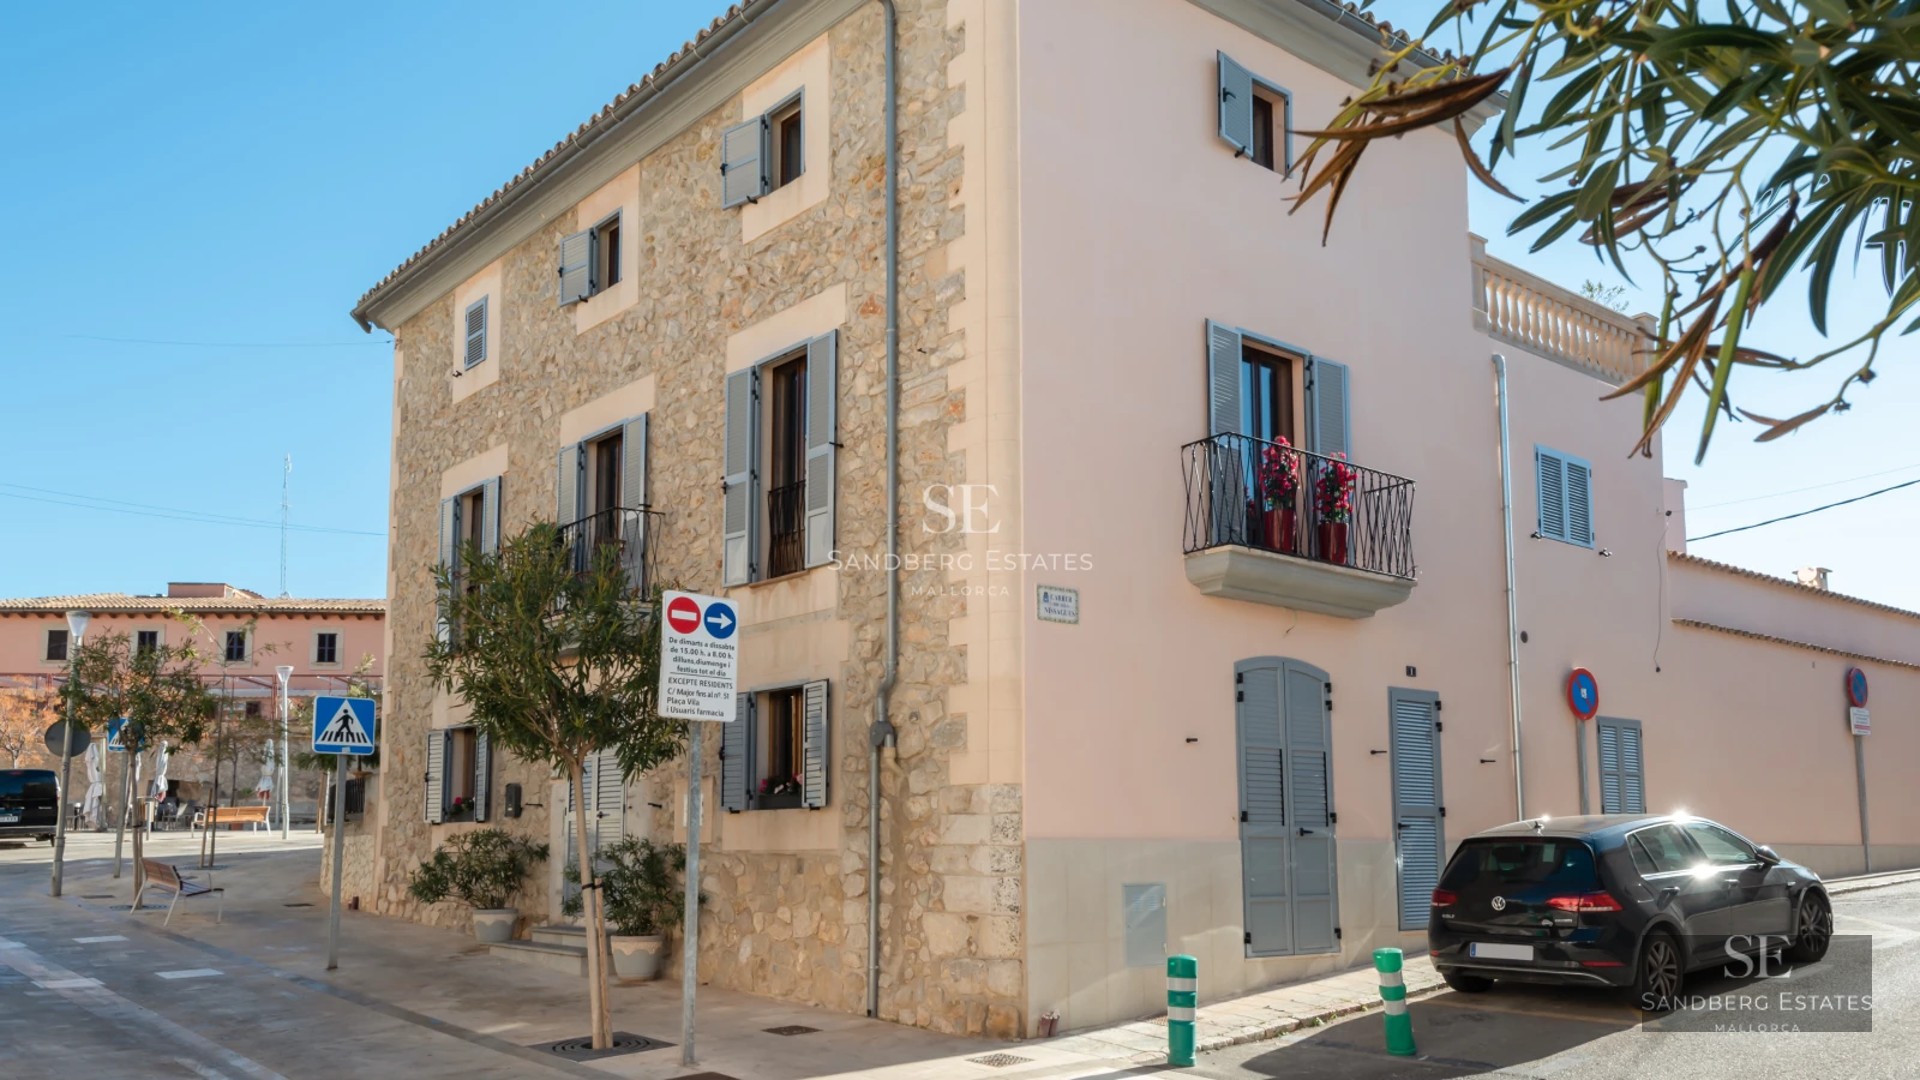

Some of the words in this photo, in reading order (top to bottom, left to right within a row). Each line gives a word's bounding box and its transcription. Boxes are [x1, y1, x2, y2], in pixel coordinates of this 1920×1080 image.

[669, 636, 677, 644] De
[679, 638, 703, 647] dimarts
[710, 642, 735, 651] dissabte
[680, 648, 698, 656] 15.00
[677, 665, 698, 674] festius
[668, 677, 698, 686] EXCEPTE
[700, 680, 733, 690] RESIDENTS
[667, 687, 675, 695] C/
[677, 688, 694, 697] Major
[667, 696, 686, 706] Plaça
[687, 698, 700, 706] Vila
[671, 706, 696, 715] Usuaris
